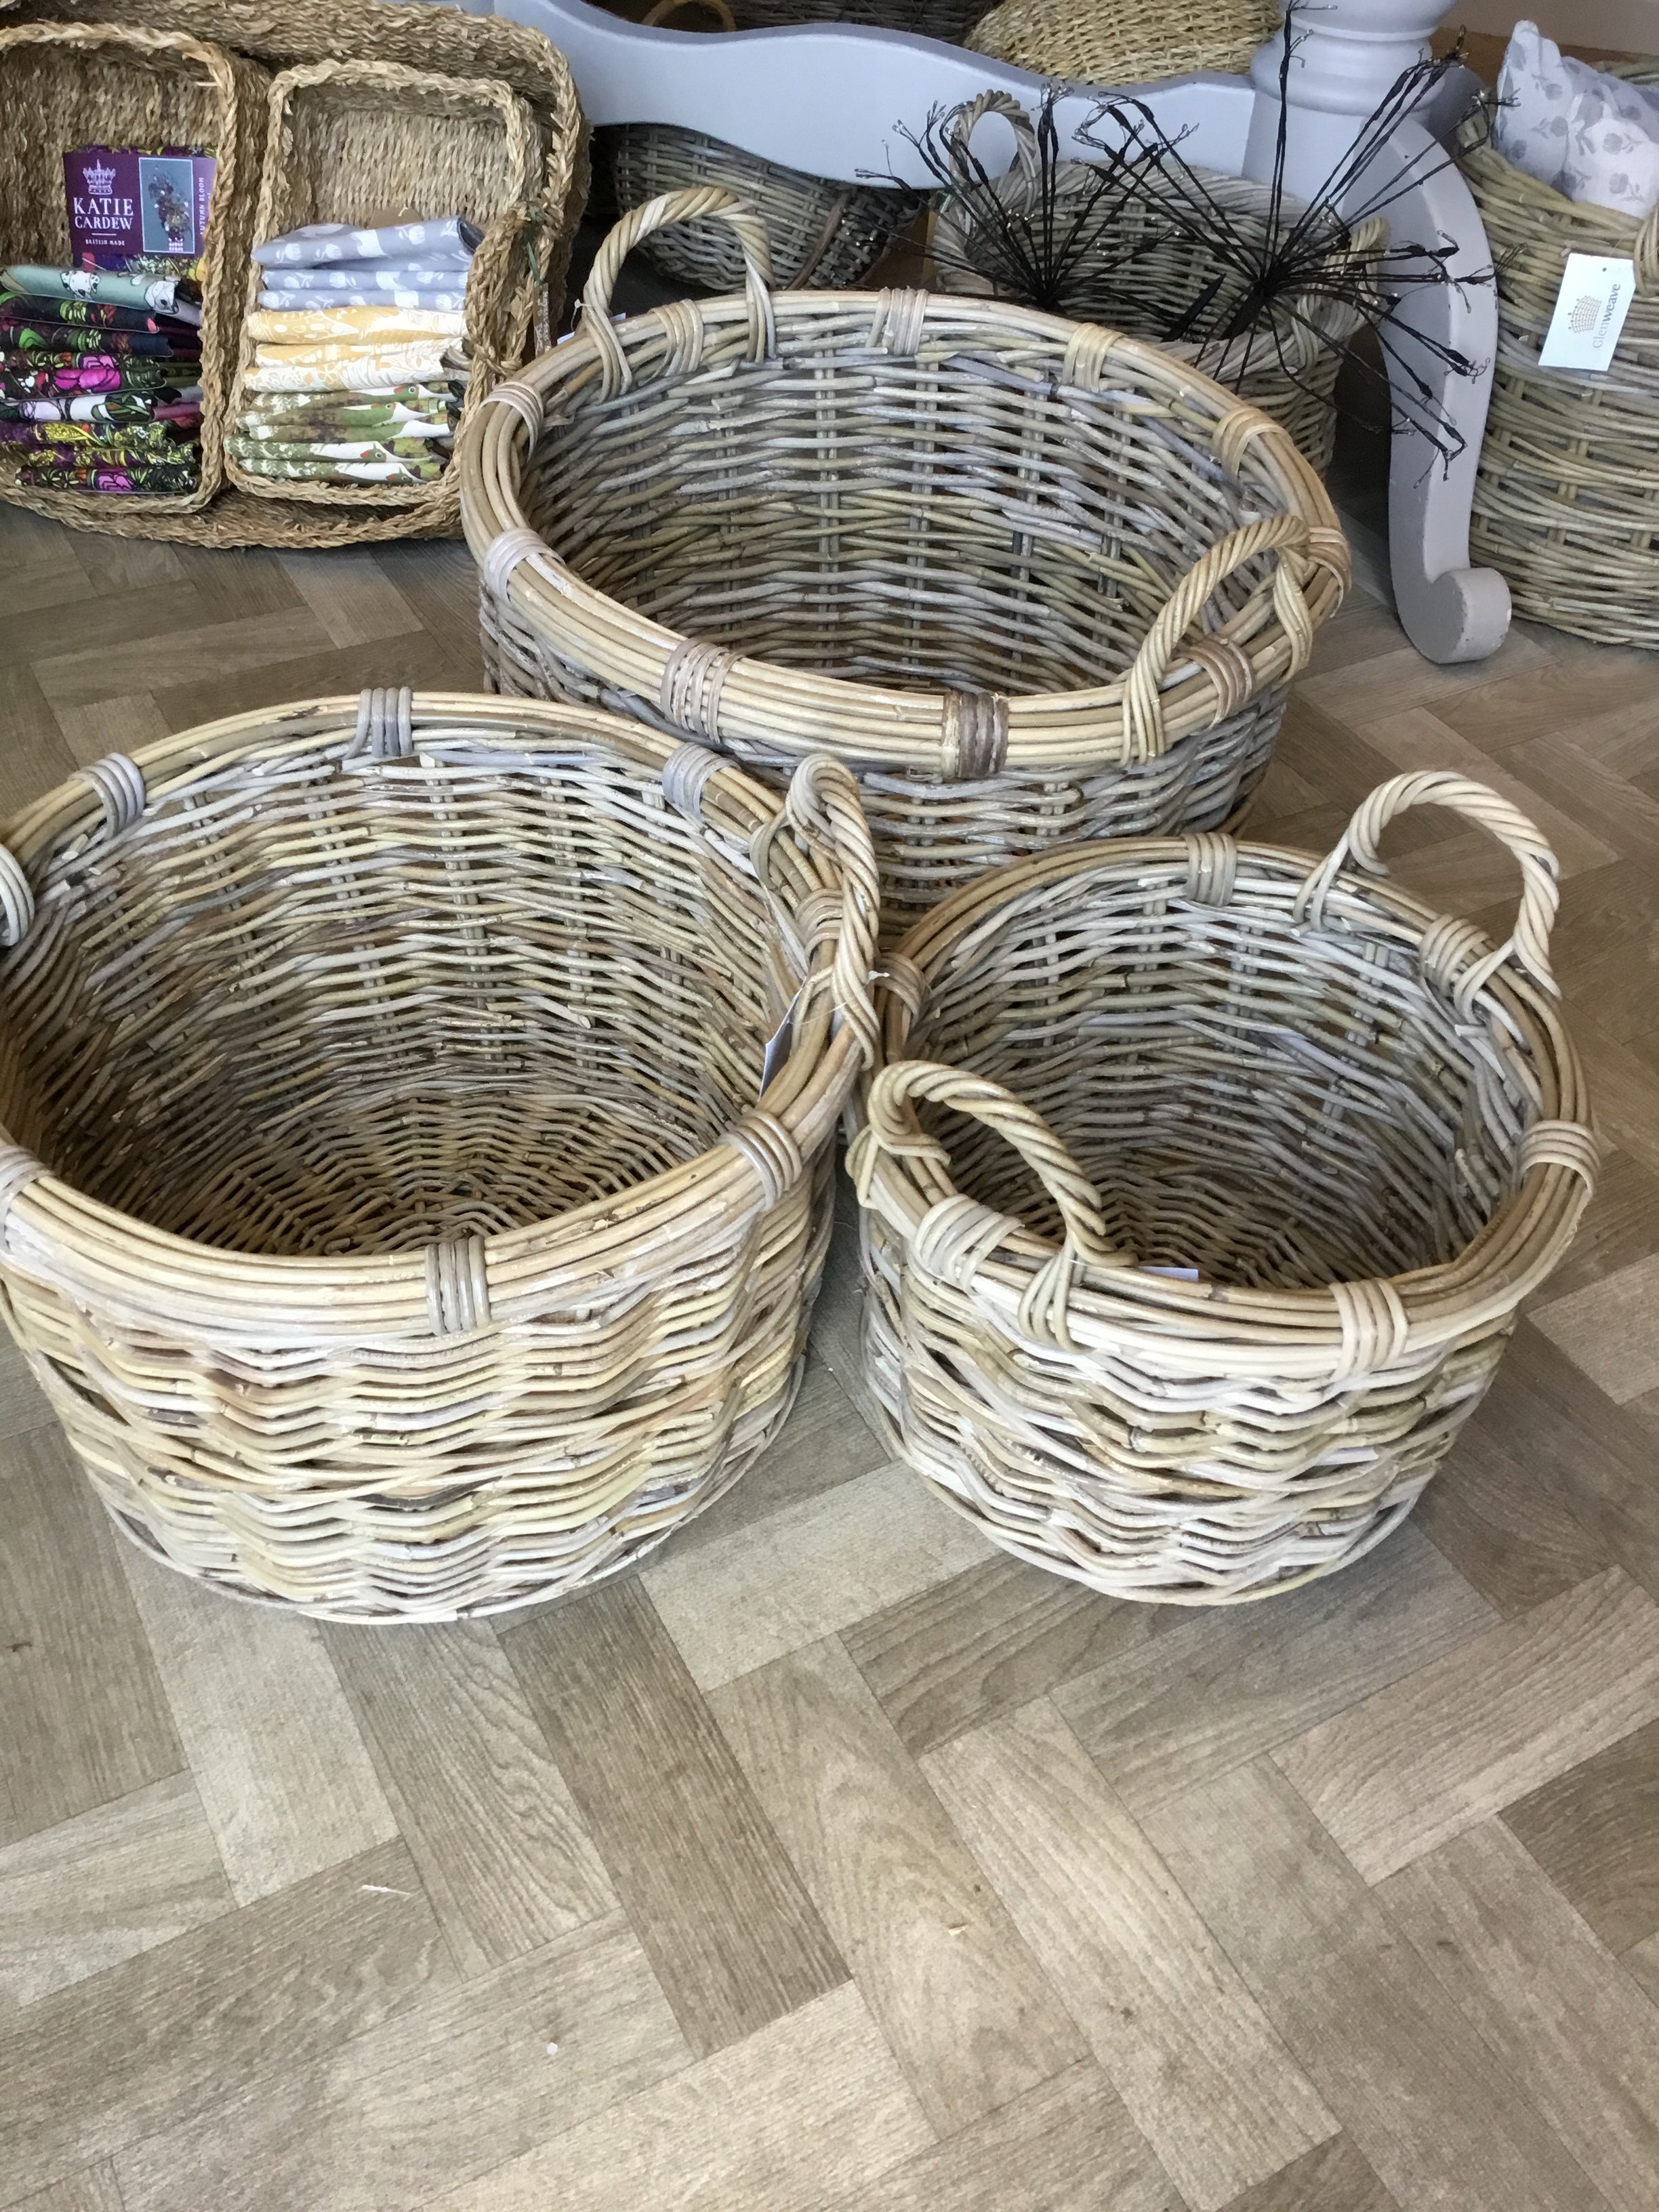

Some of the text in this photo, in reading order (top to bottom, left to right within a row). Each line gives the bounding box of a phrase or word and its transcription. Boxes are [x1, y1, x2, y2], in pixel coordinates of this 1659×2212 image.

[73, 197, 134, 216] KATIE
[75, 216, 133, 230] CARDEW
[1593, 283, 1620, 348] Glenweave
